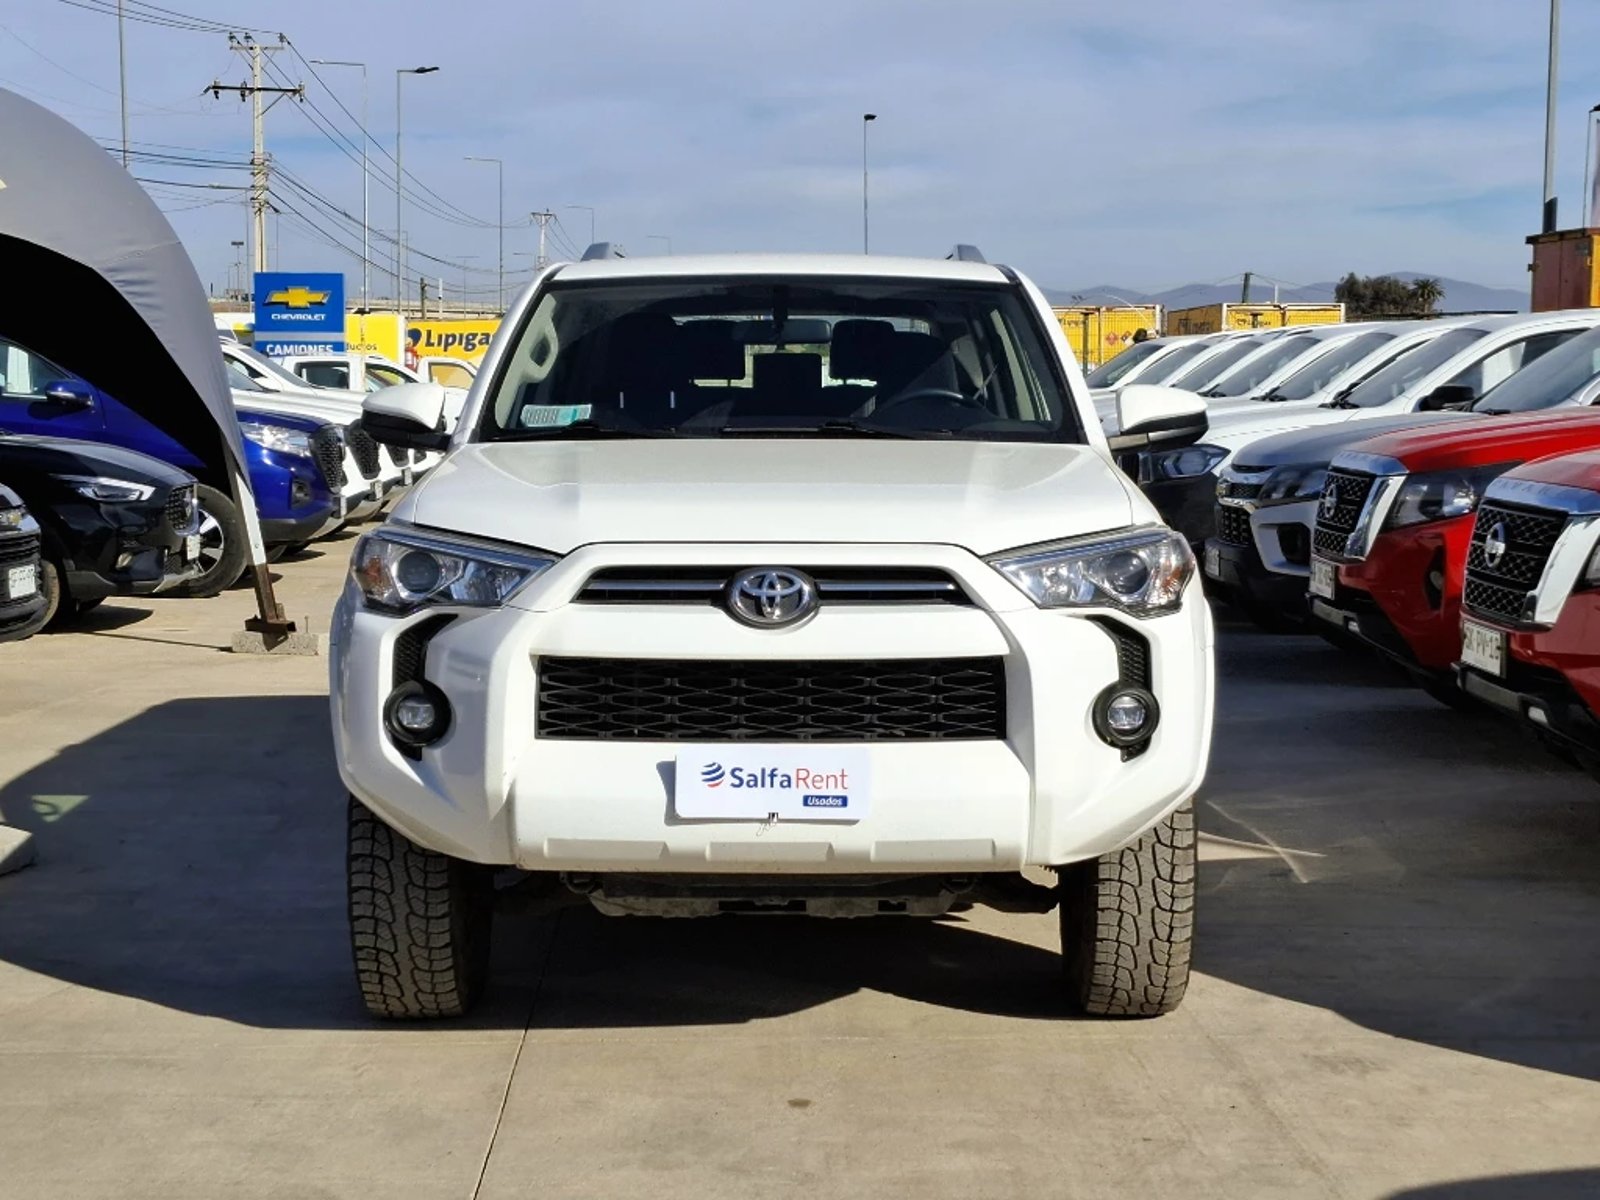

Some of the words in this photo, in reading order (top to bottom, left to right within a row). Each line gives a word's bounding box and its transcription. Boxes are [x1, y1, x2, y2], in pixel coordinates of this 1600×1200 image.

[271, 313, 326, 321] CHEVROLET
[266, 343, 334, 355] CAMIONES
[729, 767, 848, 790] SalfaRent
[807, 796, 844, 807] Usados
